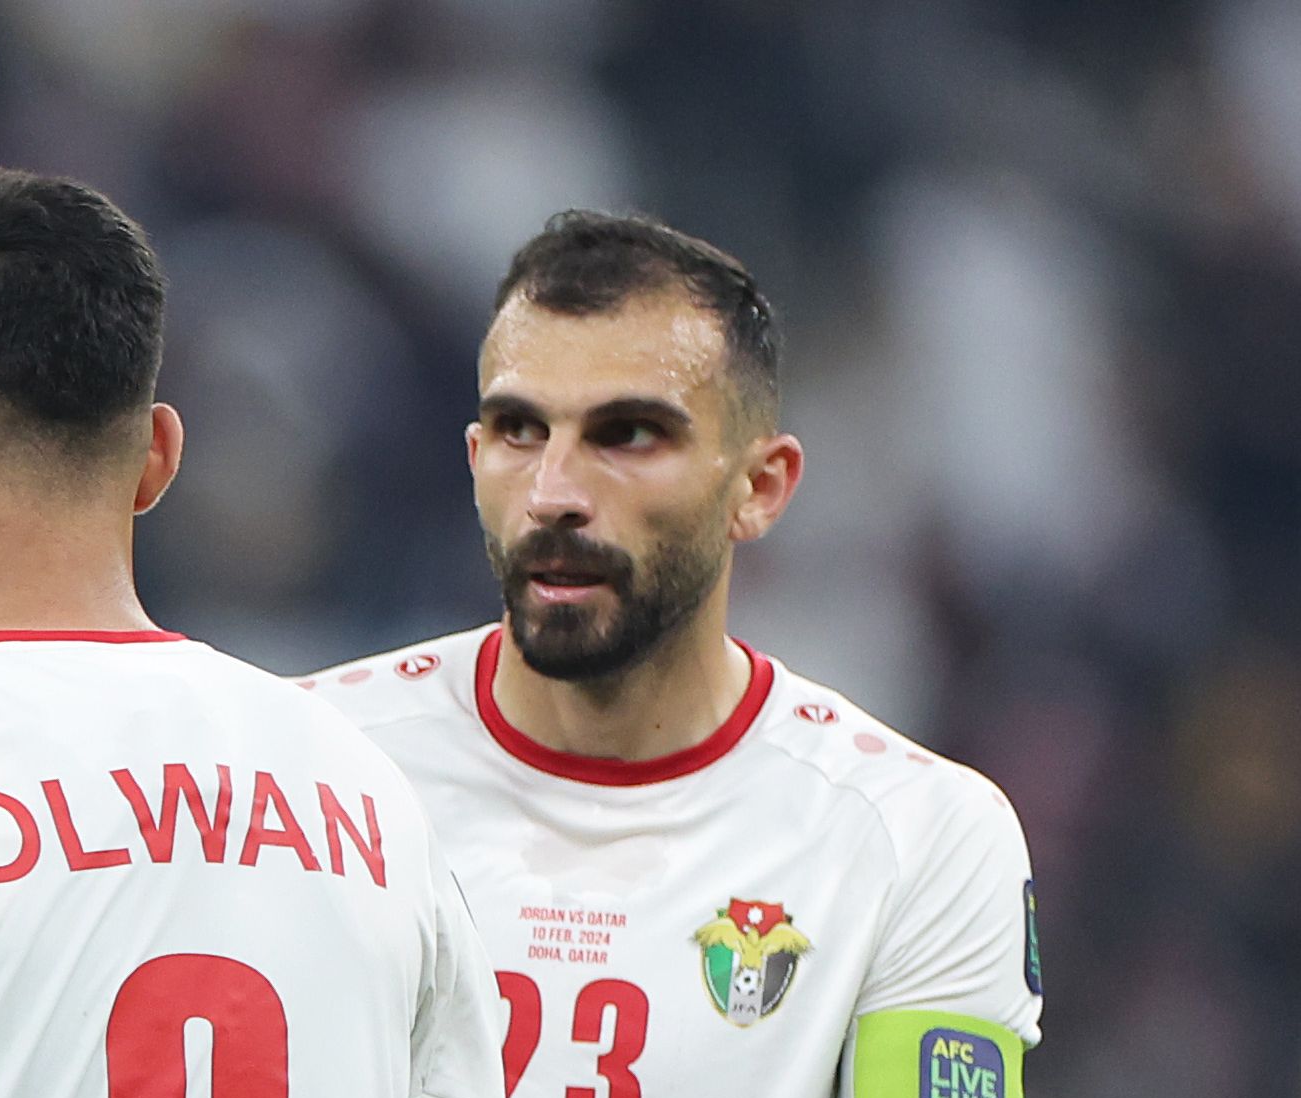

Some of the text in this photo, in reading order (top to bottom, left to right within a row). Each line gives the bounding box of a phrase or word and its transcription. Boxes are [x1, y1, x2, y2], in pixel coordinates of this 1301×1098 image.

[519, 906, 627, 928] JORDAN VS QATAR
[532, 926, 547, 941] 10
[578, 930, 611, 946] 2024
[568, 948, 609, 965] QATAR
[932, 1036, 975, 1065] AFC
